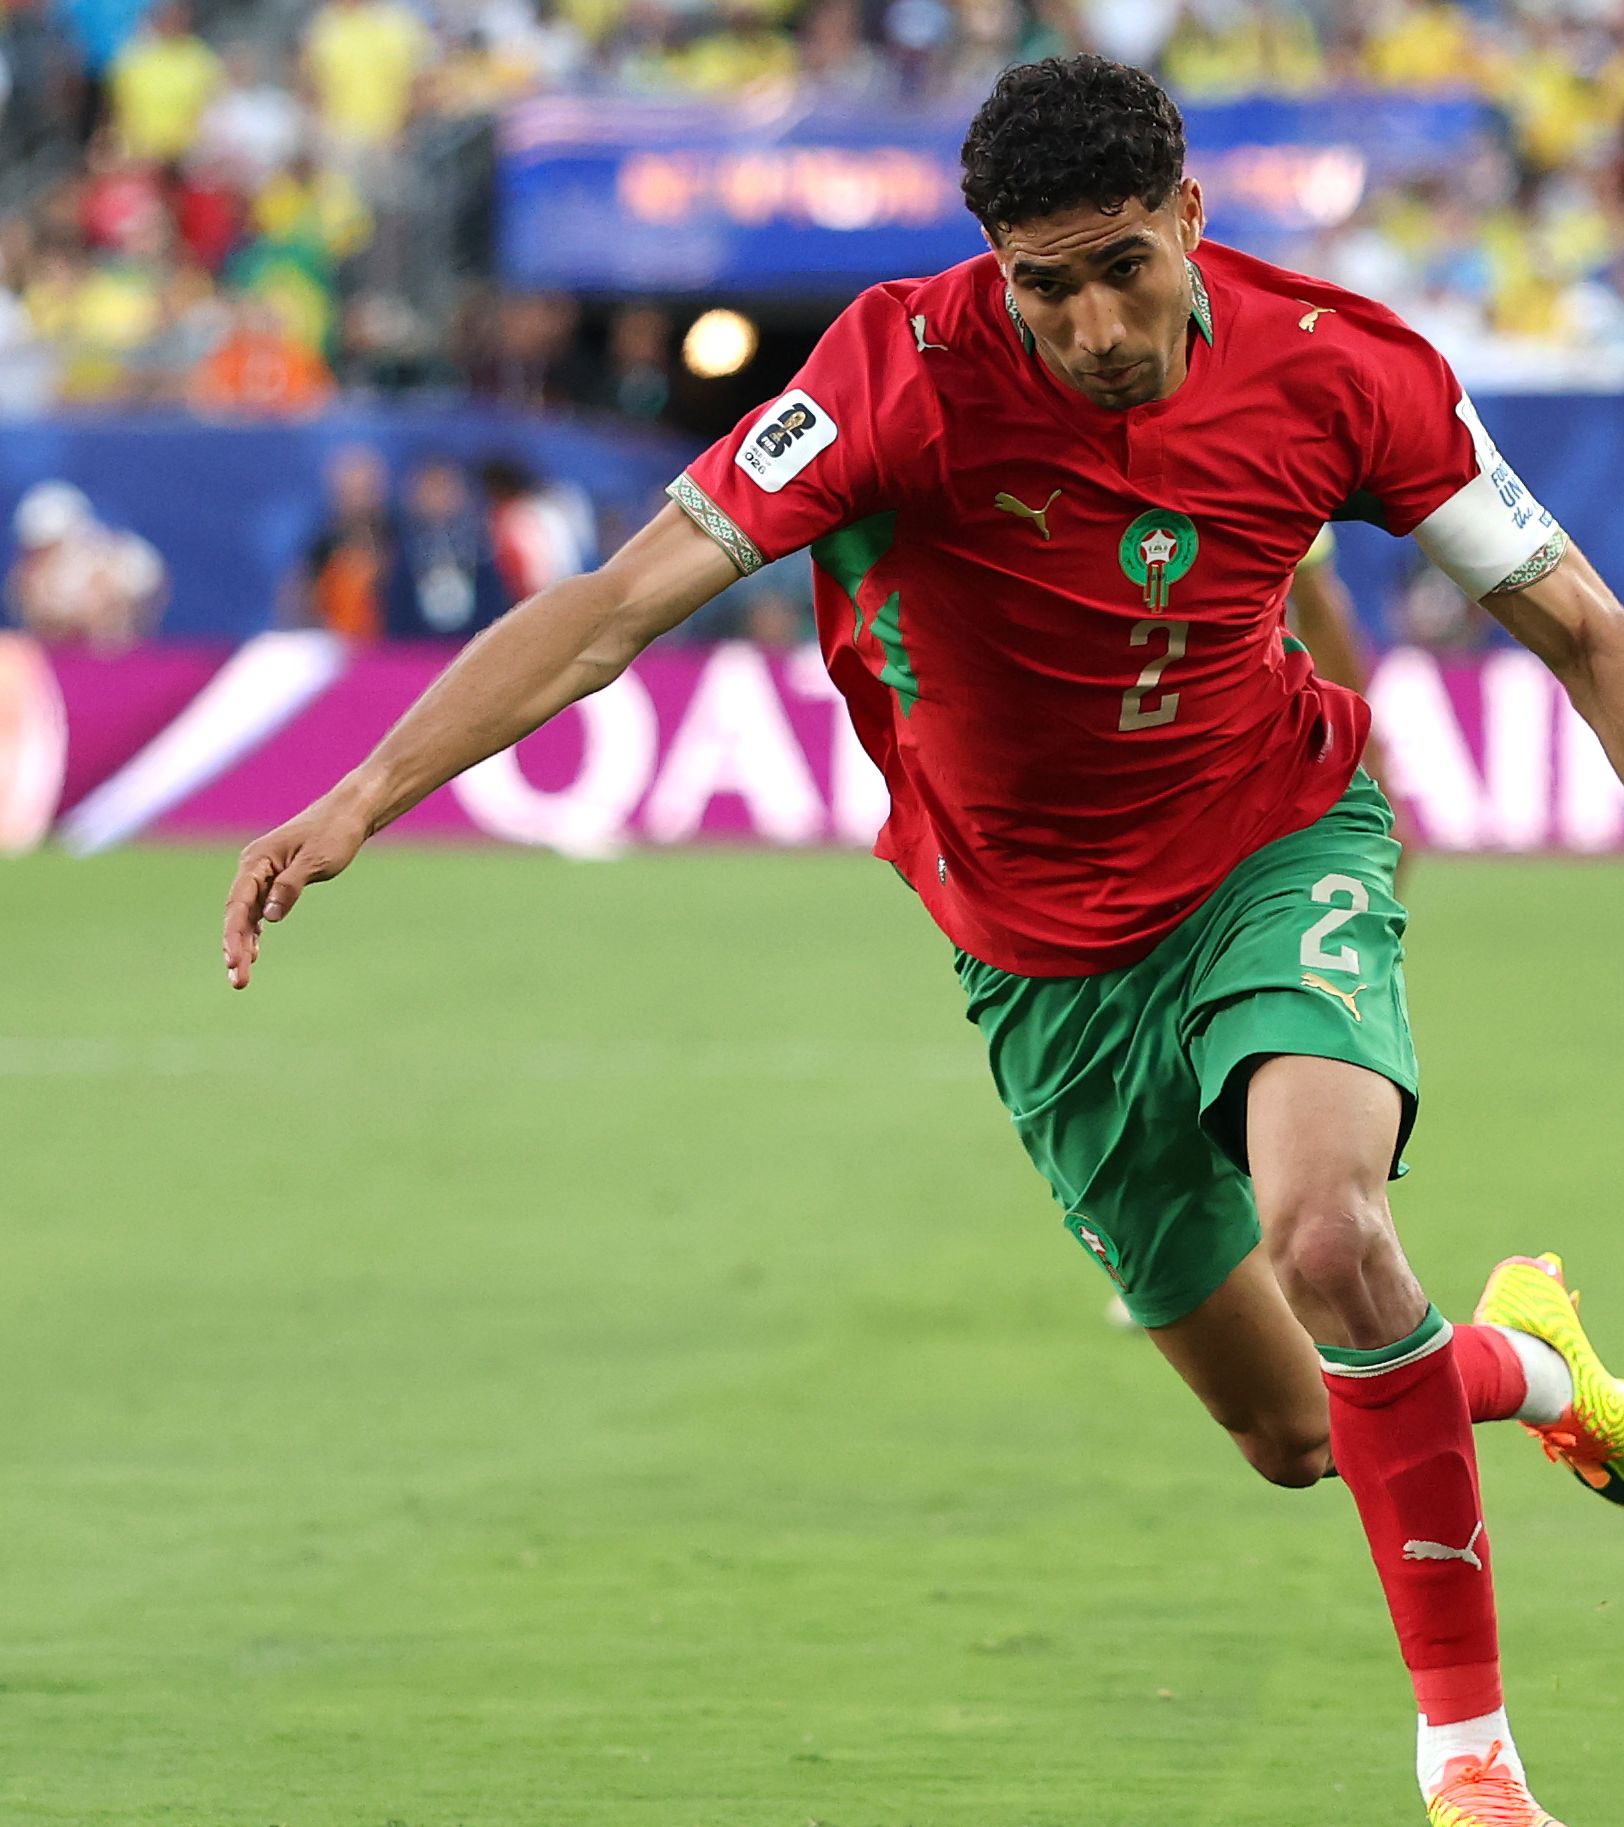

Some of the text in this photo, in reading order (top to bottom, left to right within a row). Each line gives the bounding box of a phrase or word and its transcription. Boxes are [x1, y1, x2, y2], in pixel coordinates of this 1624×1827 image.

[744, 451, 766, 475] 026
[1118, 620, 1189, 731] 2
[1300, 873, 1369, 975] 2
